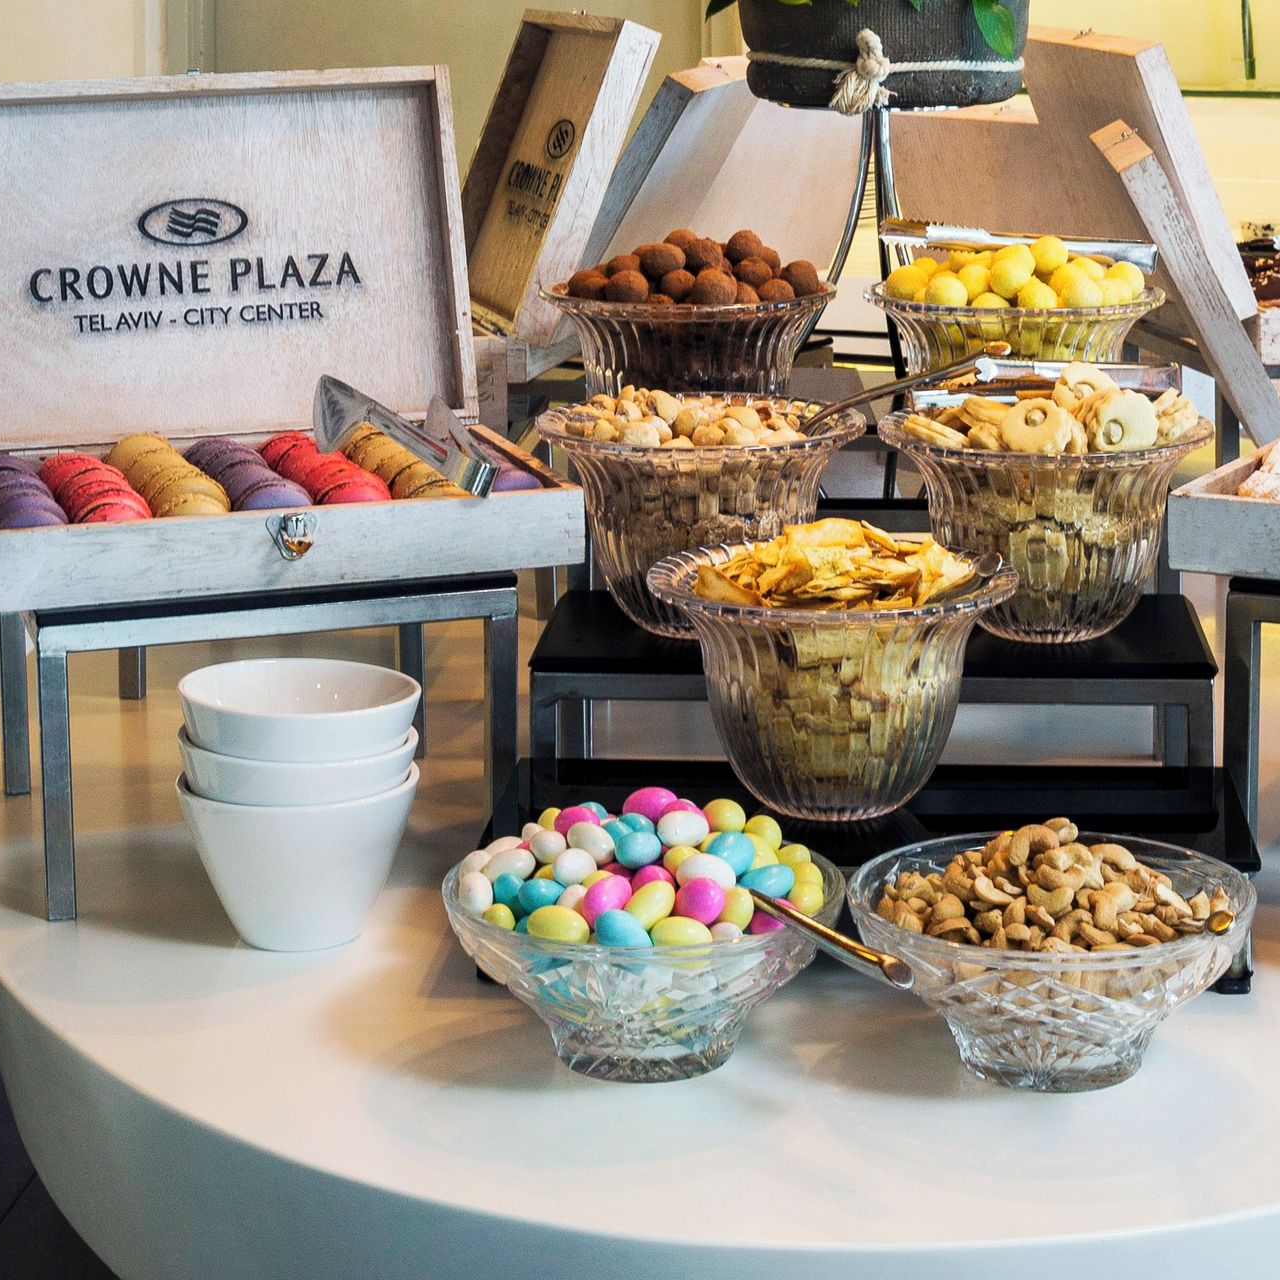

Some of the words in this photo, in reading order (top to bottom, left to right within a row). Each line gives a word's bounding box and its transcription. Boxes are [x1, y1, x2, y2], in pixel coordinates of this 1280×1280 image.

[508, 160, 551, 198] CROWNE
[29, 260, 212, 303] CROWNE
[230, 252, 362, 292] PLAZA
[75, 314, 112, 333] TEL
[116, 310, 163, 330] AVIV
[183, 306, 232, 327] CITY
[240, 301, 324, 324] CENTER
